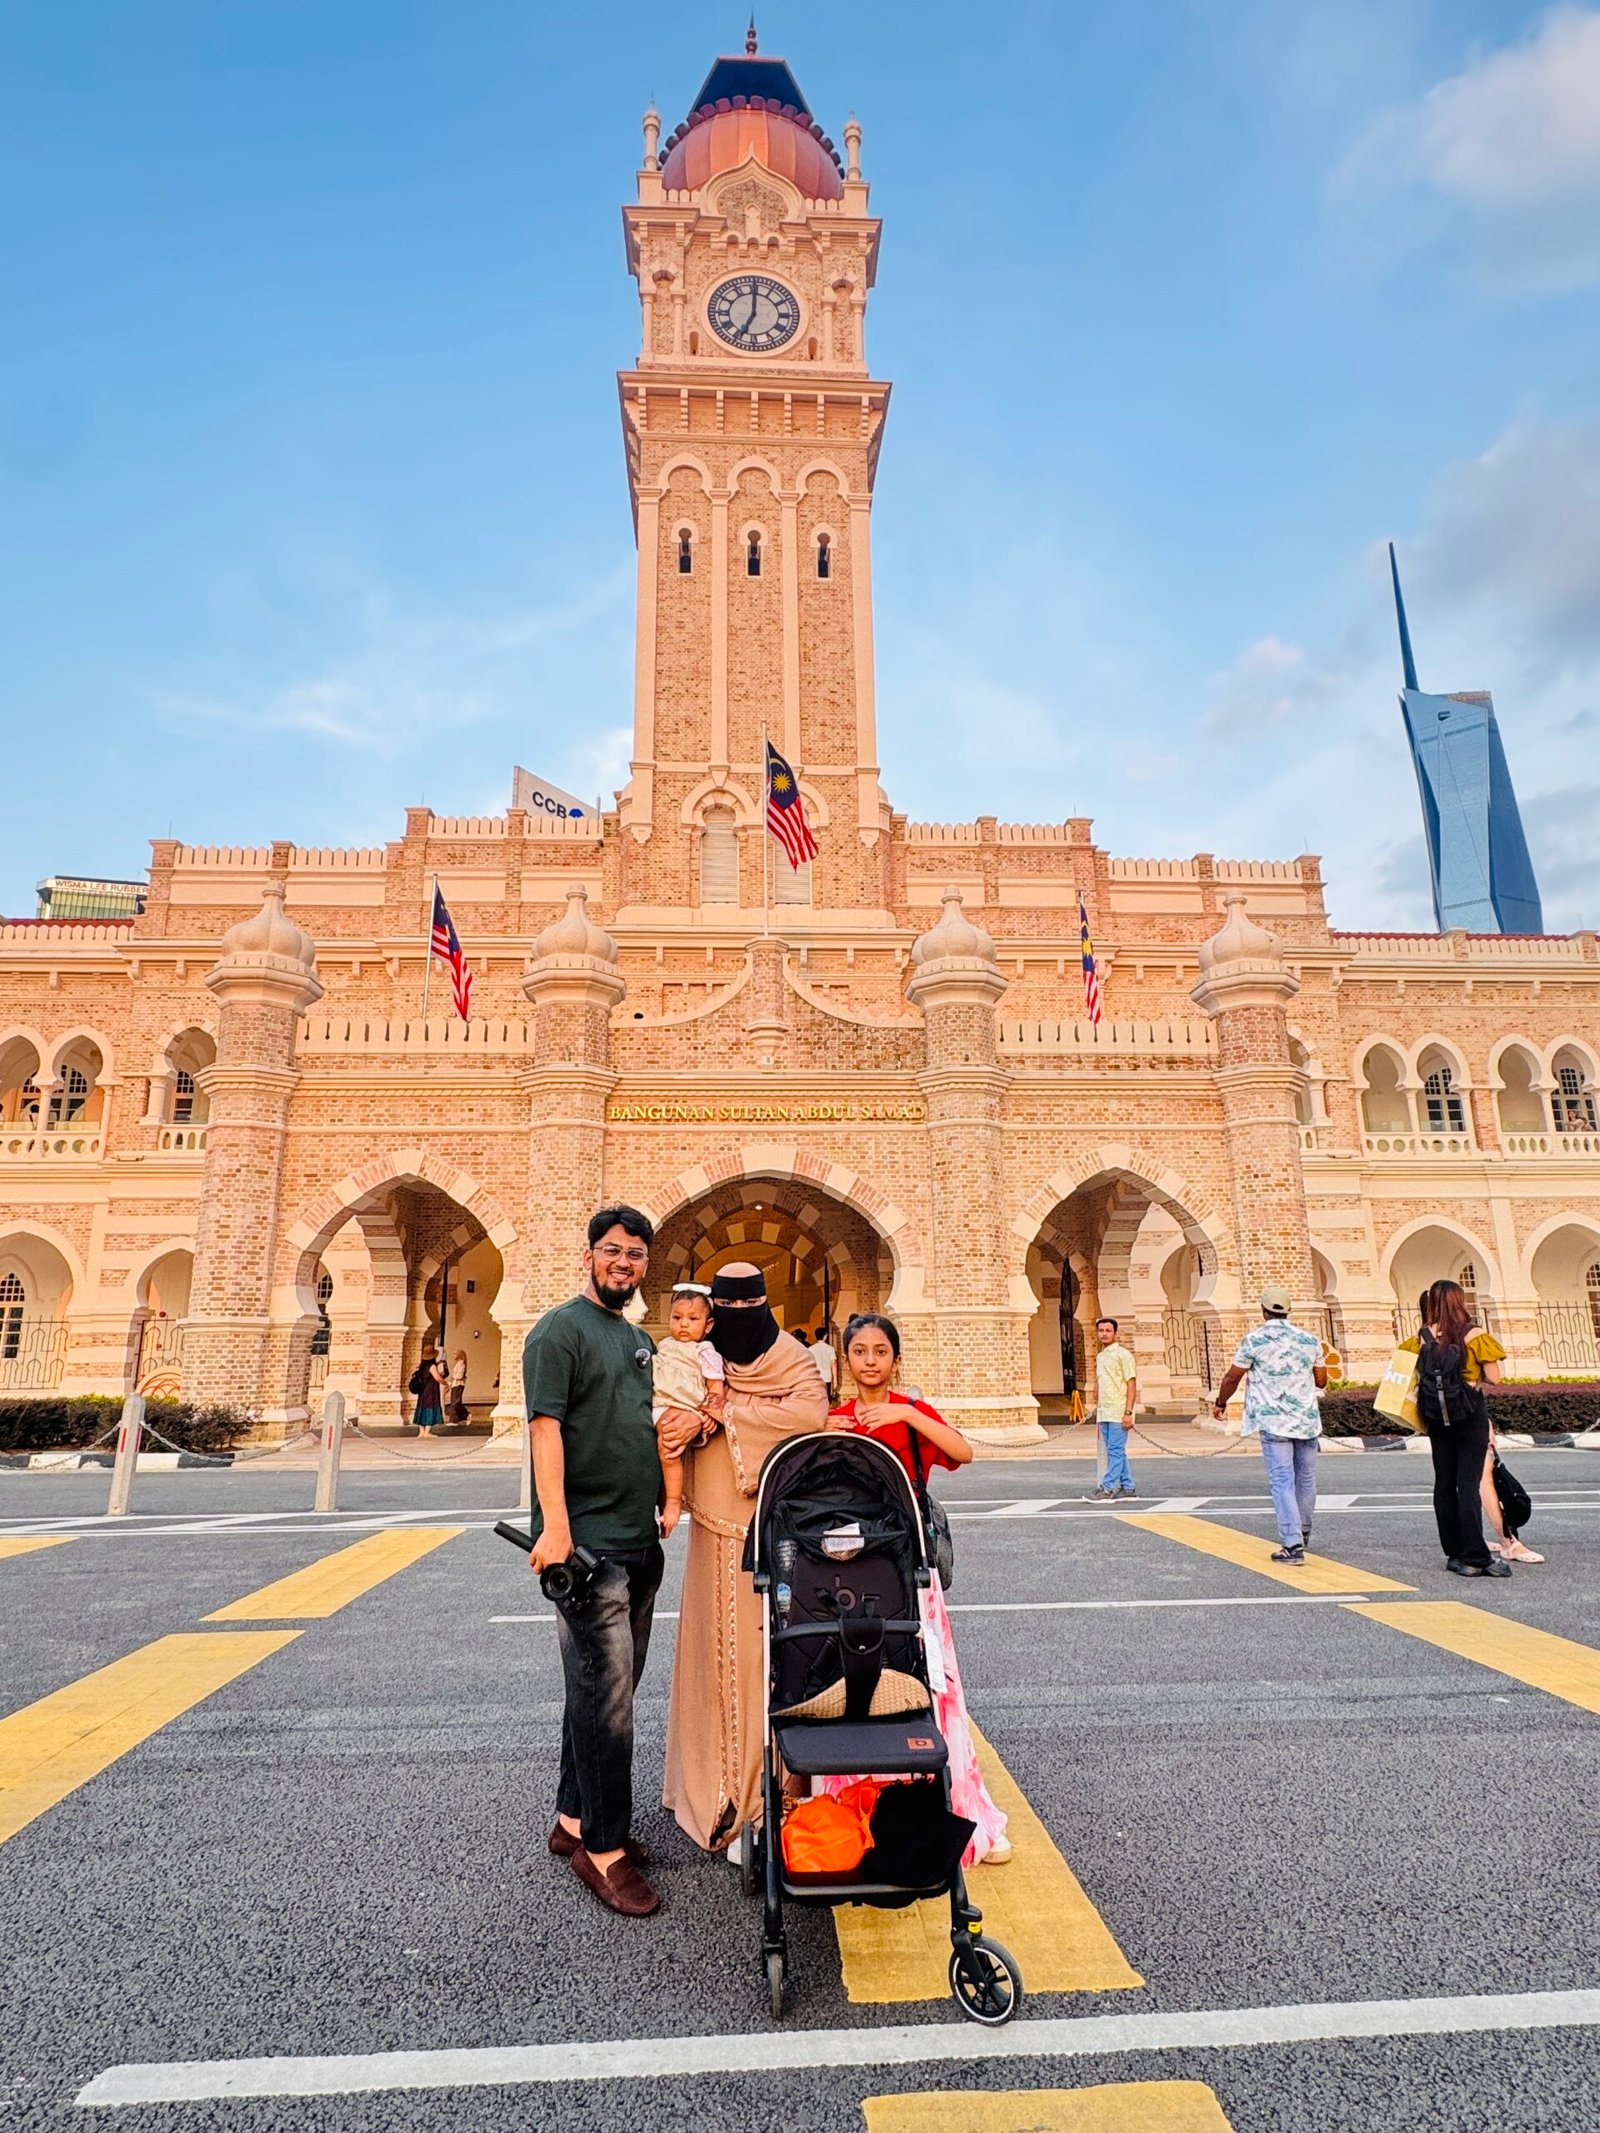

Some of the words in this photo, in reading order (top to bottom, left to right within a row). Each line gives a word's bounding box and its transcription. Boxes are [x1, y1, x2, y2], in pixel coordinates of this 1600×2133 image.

[532, 791, 567, 819] CCB
[55, 880, 87, 889] WISMA
[90, 883, 108, 891] LEE
[610, 1105, 715, 1120] BANGUNAN
[719, 1105, 790, 1120] SULTAN
[795, 1105, 854, 1120] ABDUL
[861, 1105, 926, 1120] SAMAD
